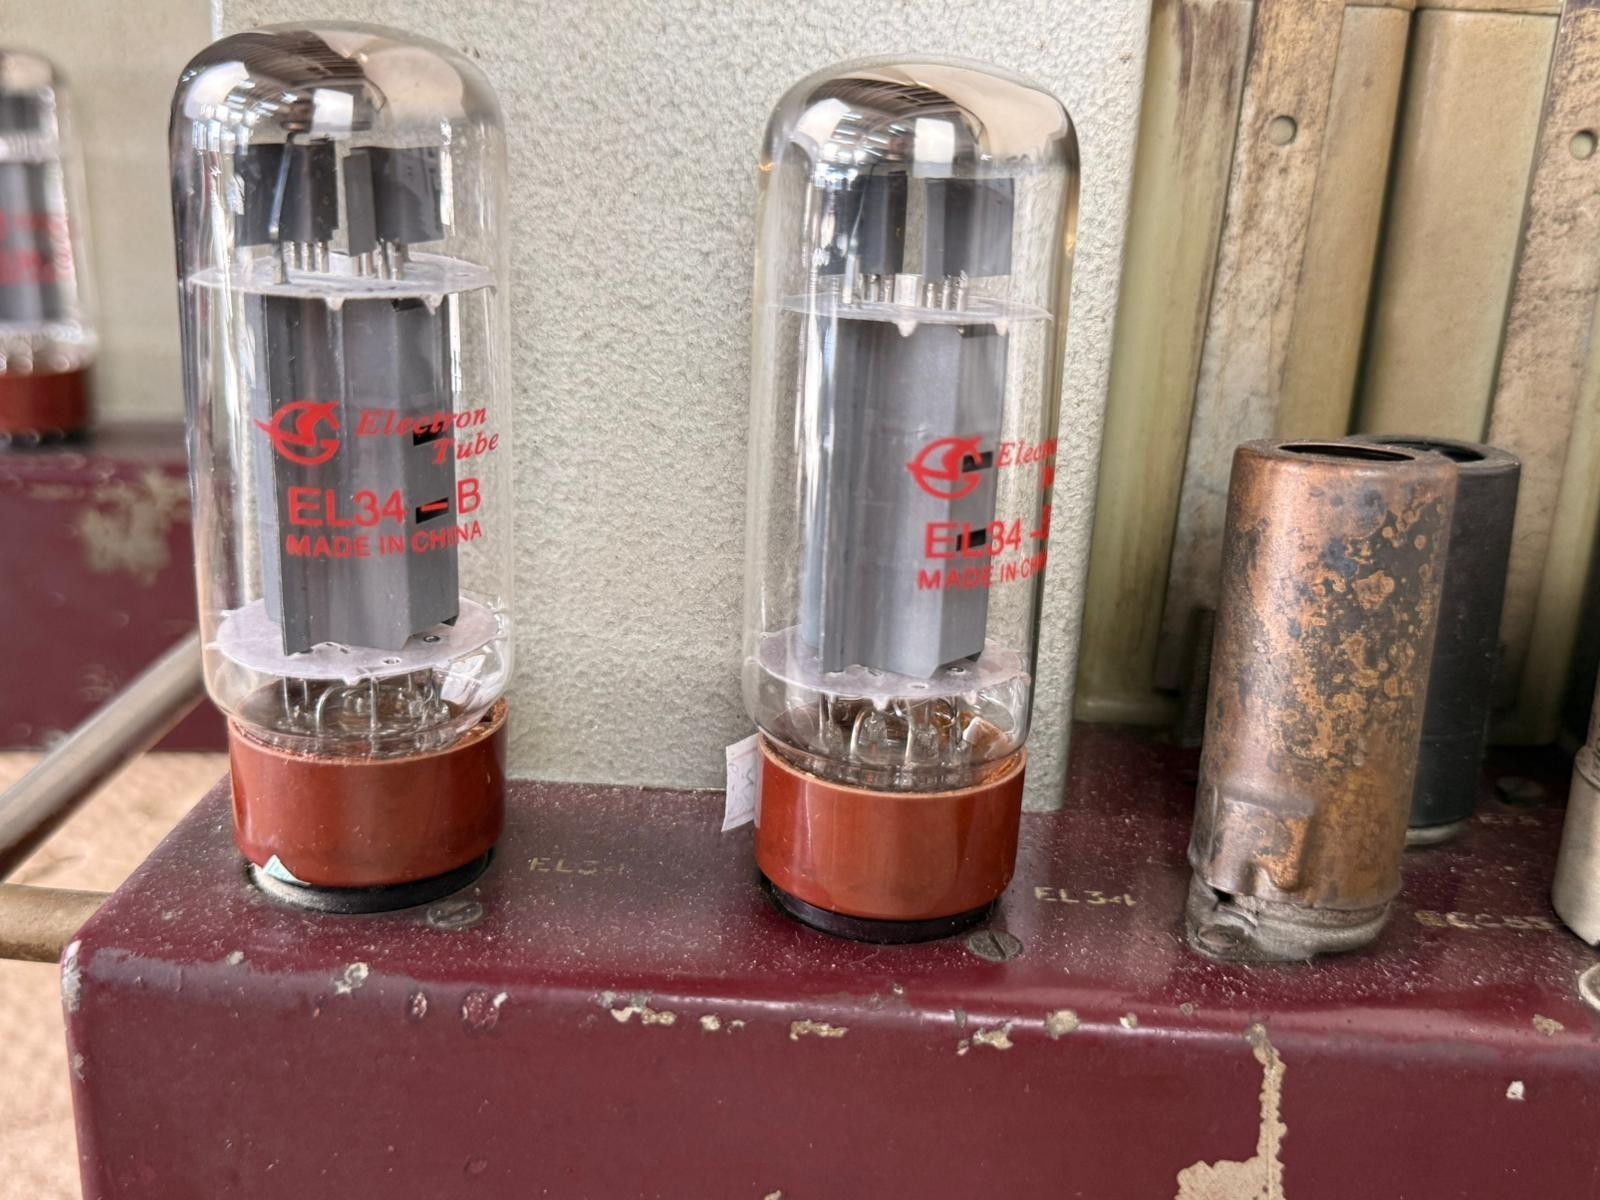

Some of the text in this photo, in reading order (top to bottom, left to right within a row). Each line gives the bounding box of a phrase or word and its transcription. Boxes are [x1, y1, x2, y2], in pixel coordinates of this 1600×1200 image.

[355, 408, 487, 437] Electron
[432, 432, 499, 465] Tube
[286, 520, 483, 560] MADE IN CHINA
[917, 564, 993, 591] MADE
[1001, 562, 1018, 583] IN
